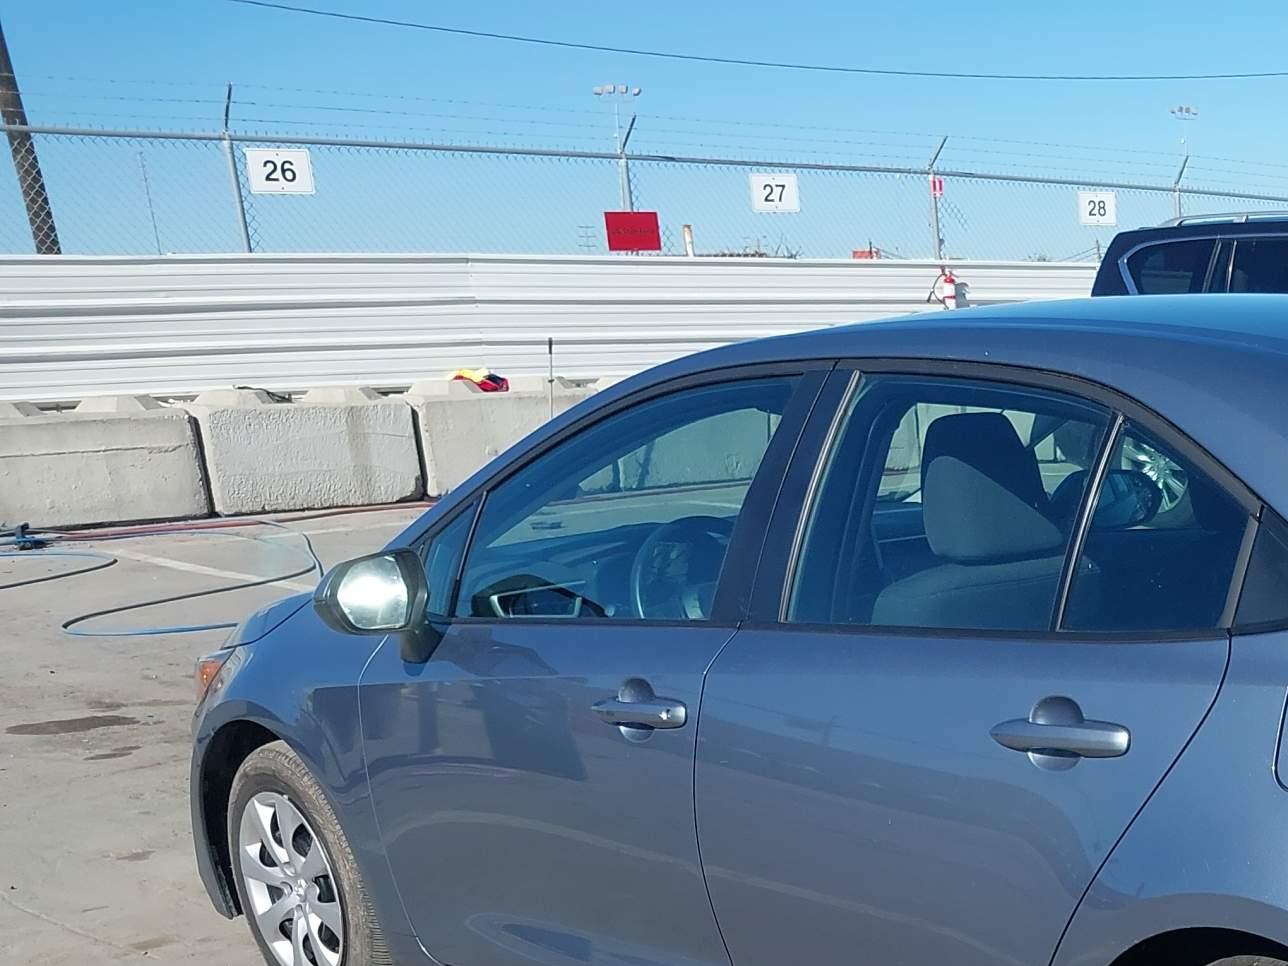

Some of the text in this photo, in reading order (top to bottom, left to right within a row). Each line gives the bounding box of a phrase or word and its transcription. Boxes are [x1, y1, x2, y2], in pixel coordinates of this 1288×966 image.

[263, 160, 297, 183] 26
[763, 184, 786, 203] 27
[1088, 200, 1106, 217] 28
